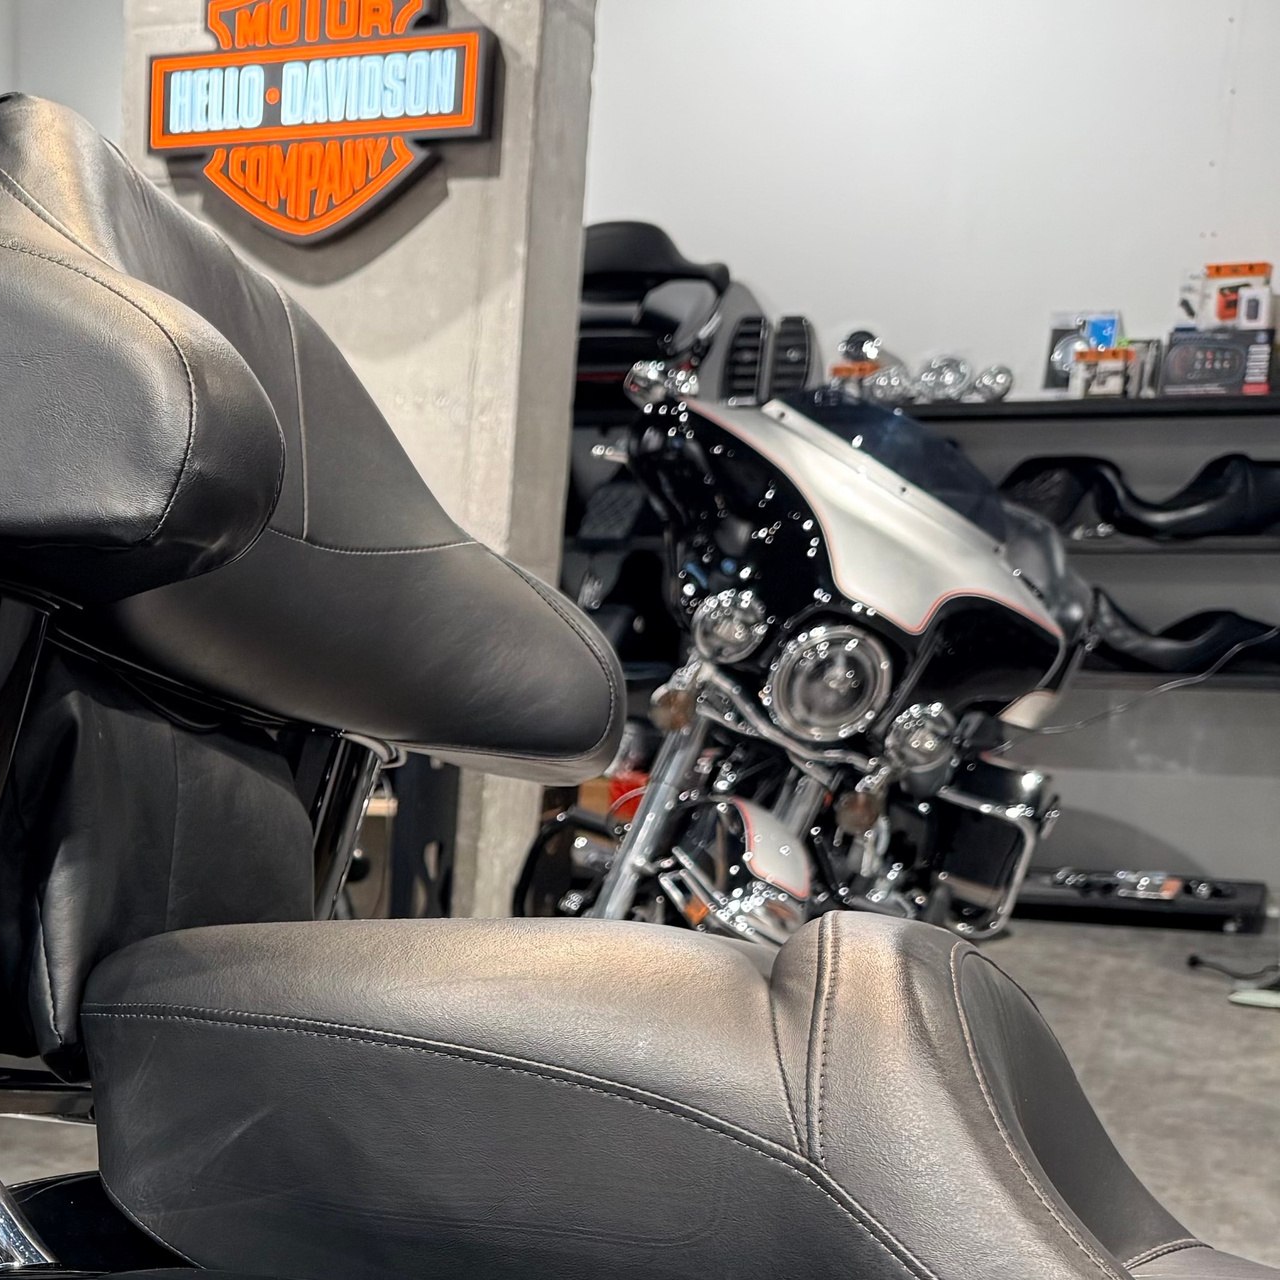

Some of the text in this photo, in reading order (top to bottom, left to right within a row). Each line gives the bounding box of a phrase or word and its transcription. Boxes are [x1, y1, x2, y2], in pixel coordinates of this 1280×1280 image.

[170, 49, 457, 133] HELLO DAVIDSON
[228, 136, 389, 220] COMPANY
